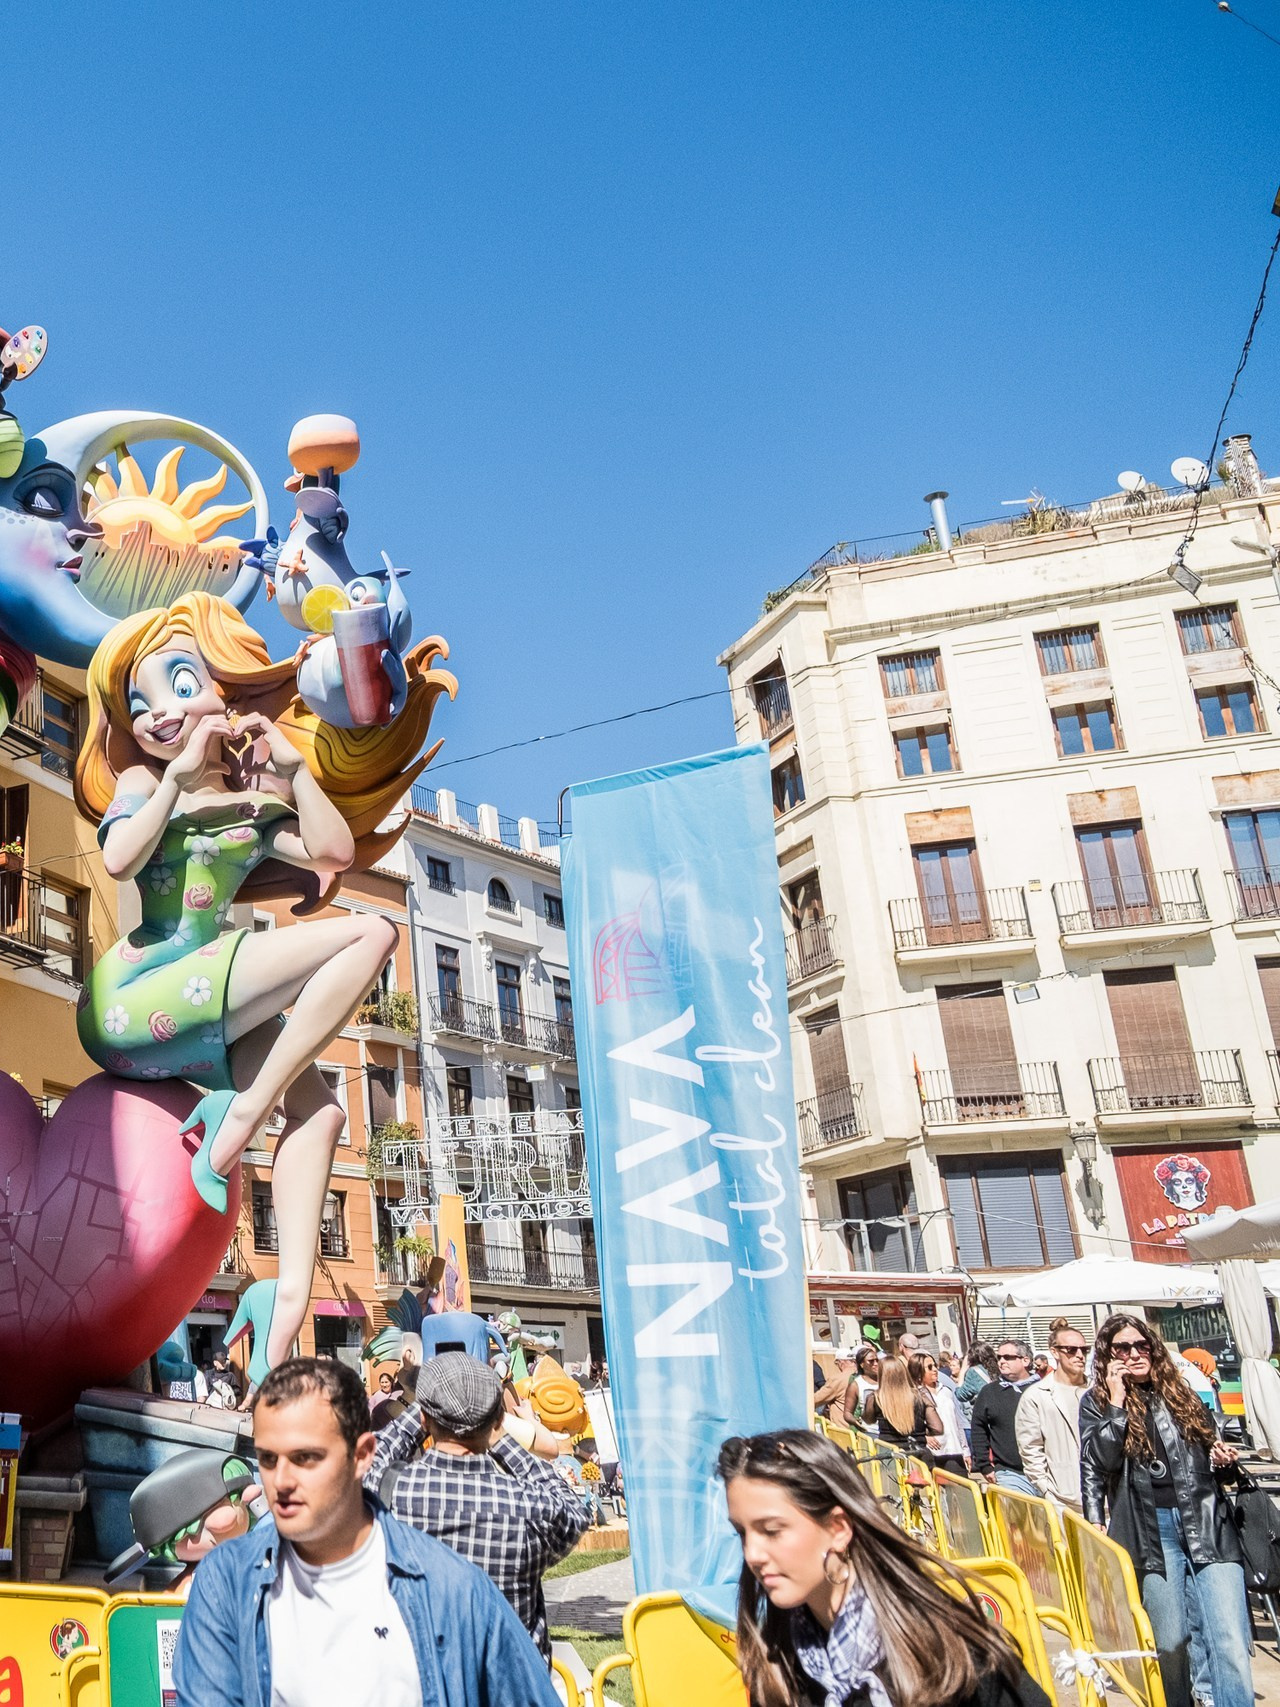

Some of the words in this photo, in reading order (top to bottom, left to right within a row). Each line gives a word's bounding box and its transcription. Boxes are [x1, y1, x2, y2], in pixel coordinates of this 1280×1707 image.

[694, 916, 782, 1093] clean
[392, 1203, 537, 1225] VALNCIA
[709, 1110, 789, 1293] total
[1141, 1217, 1166, 1236] LA
